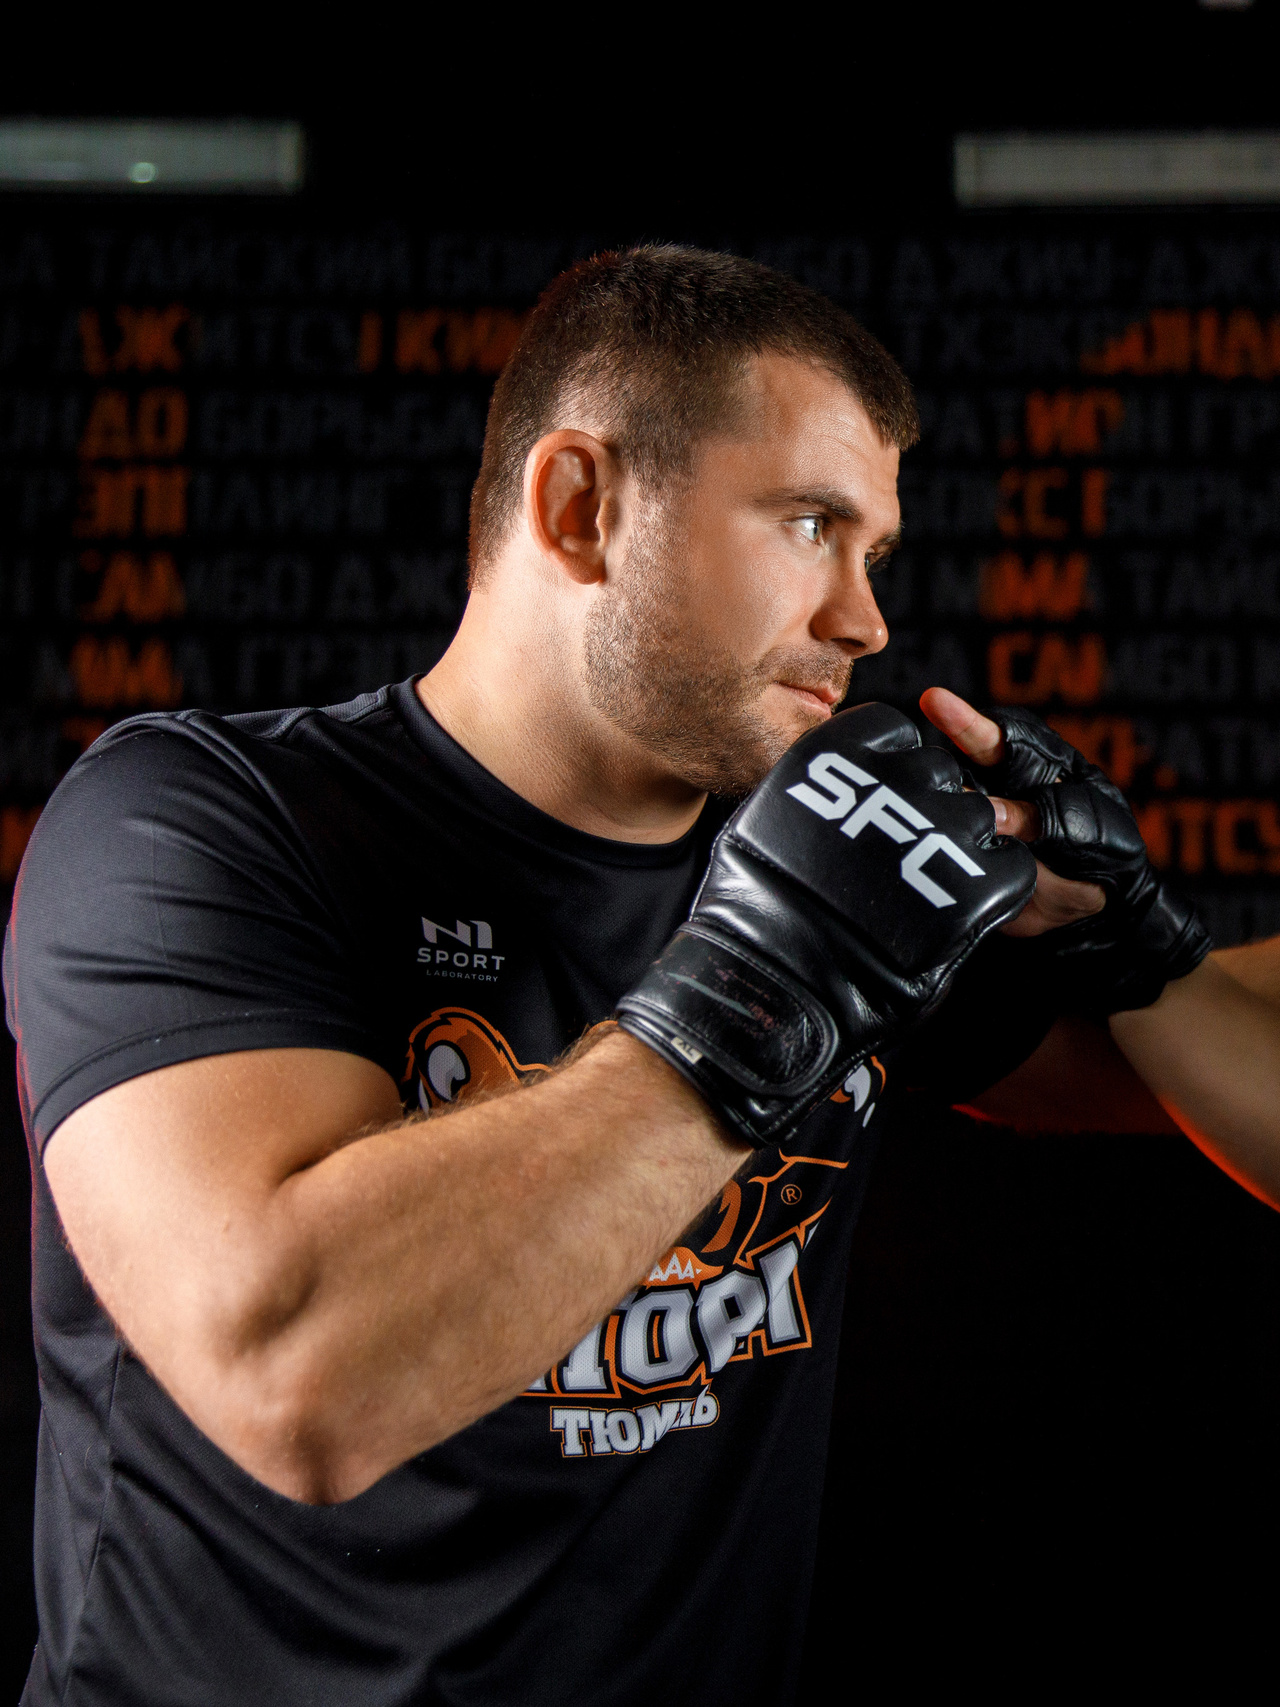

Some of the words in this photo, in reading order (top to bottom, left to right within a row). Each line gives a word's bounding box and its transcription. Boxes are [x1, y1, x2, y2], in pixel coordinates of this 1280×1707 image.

[82, 218, 412, 296] ТАЙСКИЙ
[424, 230, 598, 297] БОК
[53, 547, 315, 625] САМБО
[927, 546, 1106, 623] ММА
[27, 630, 215, 710] ММА
[985, 628, 1242, 706] САМБО
[786, 752, 986, 909] SFC
[416, 947, 506, 971] SPORT
[426, 969, 499, 983] LABORATORY
